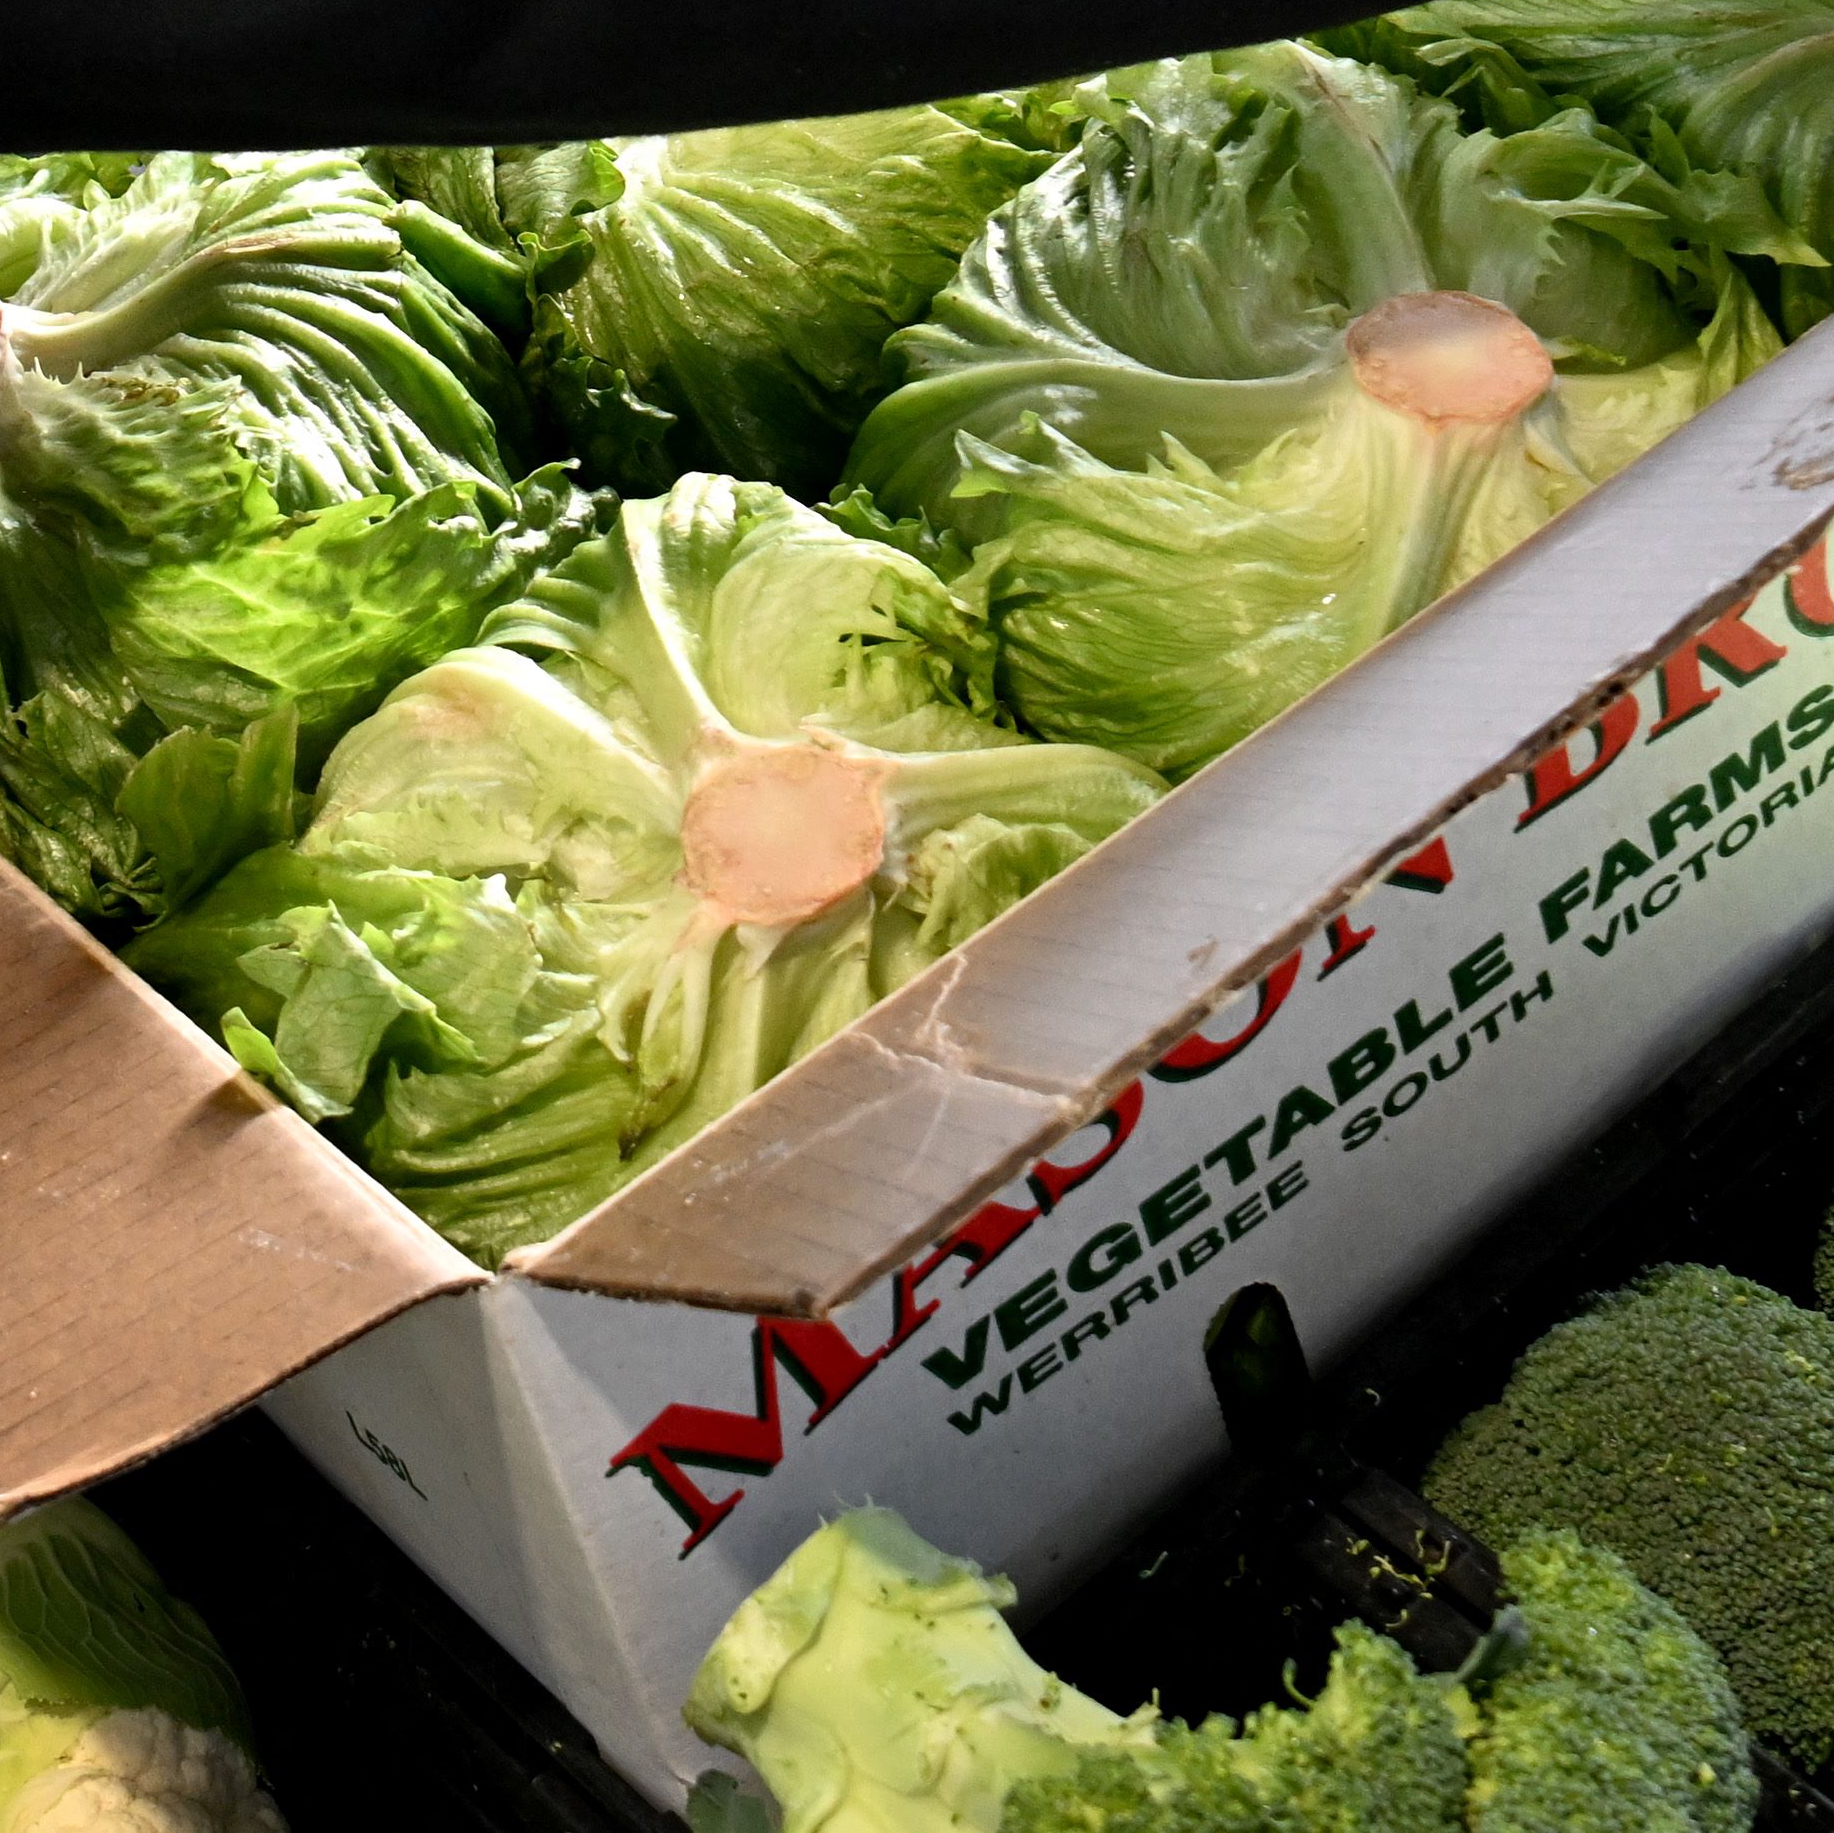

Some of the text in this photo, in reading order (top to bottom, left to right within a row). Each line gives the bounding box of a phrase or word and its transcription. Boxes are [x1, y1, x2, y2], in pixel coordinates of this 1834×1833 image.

[921, 932, 1514, 1391] VEGETABLE
[947, 1160, 1310, 1437] WERRIBEE
[1340, 970, 1554, 1153] SOUTH
